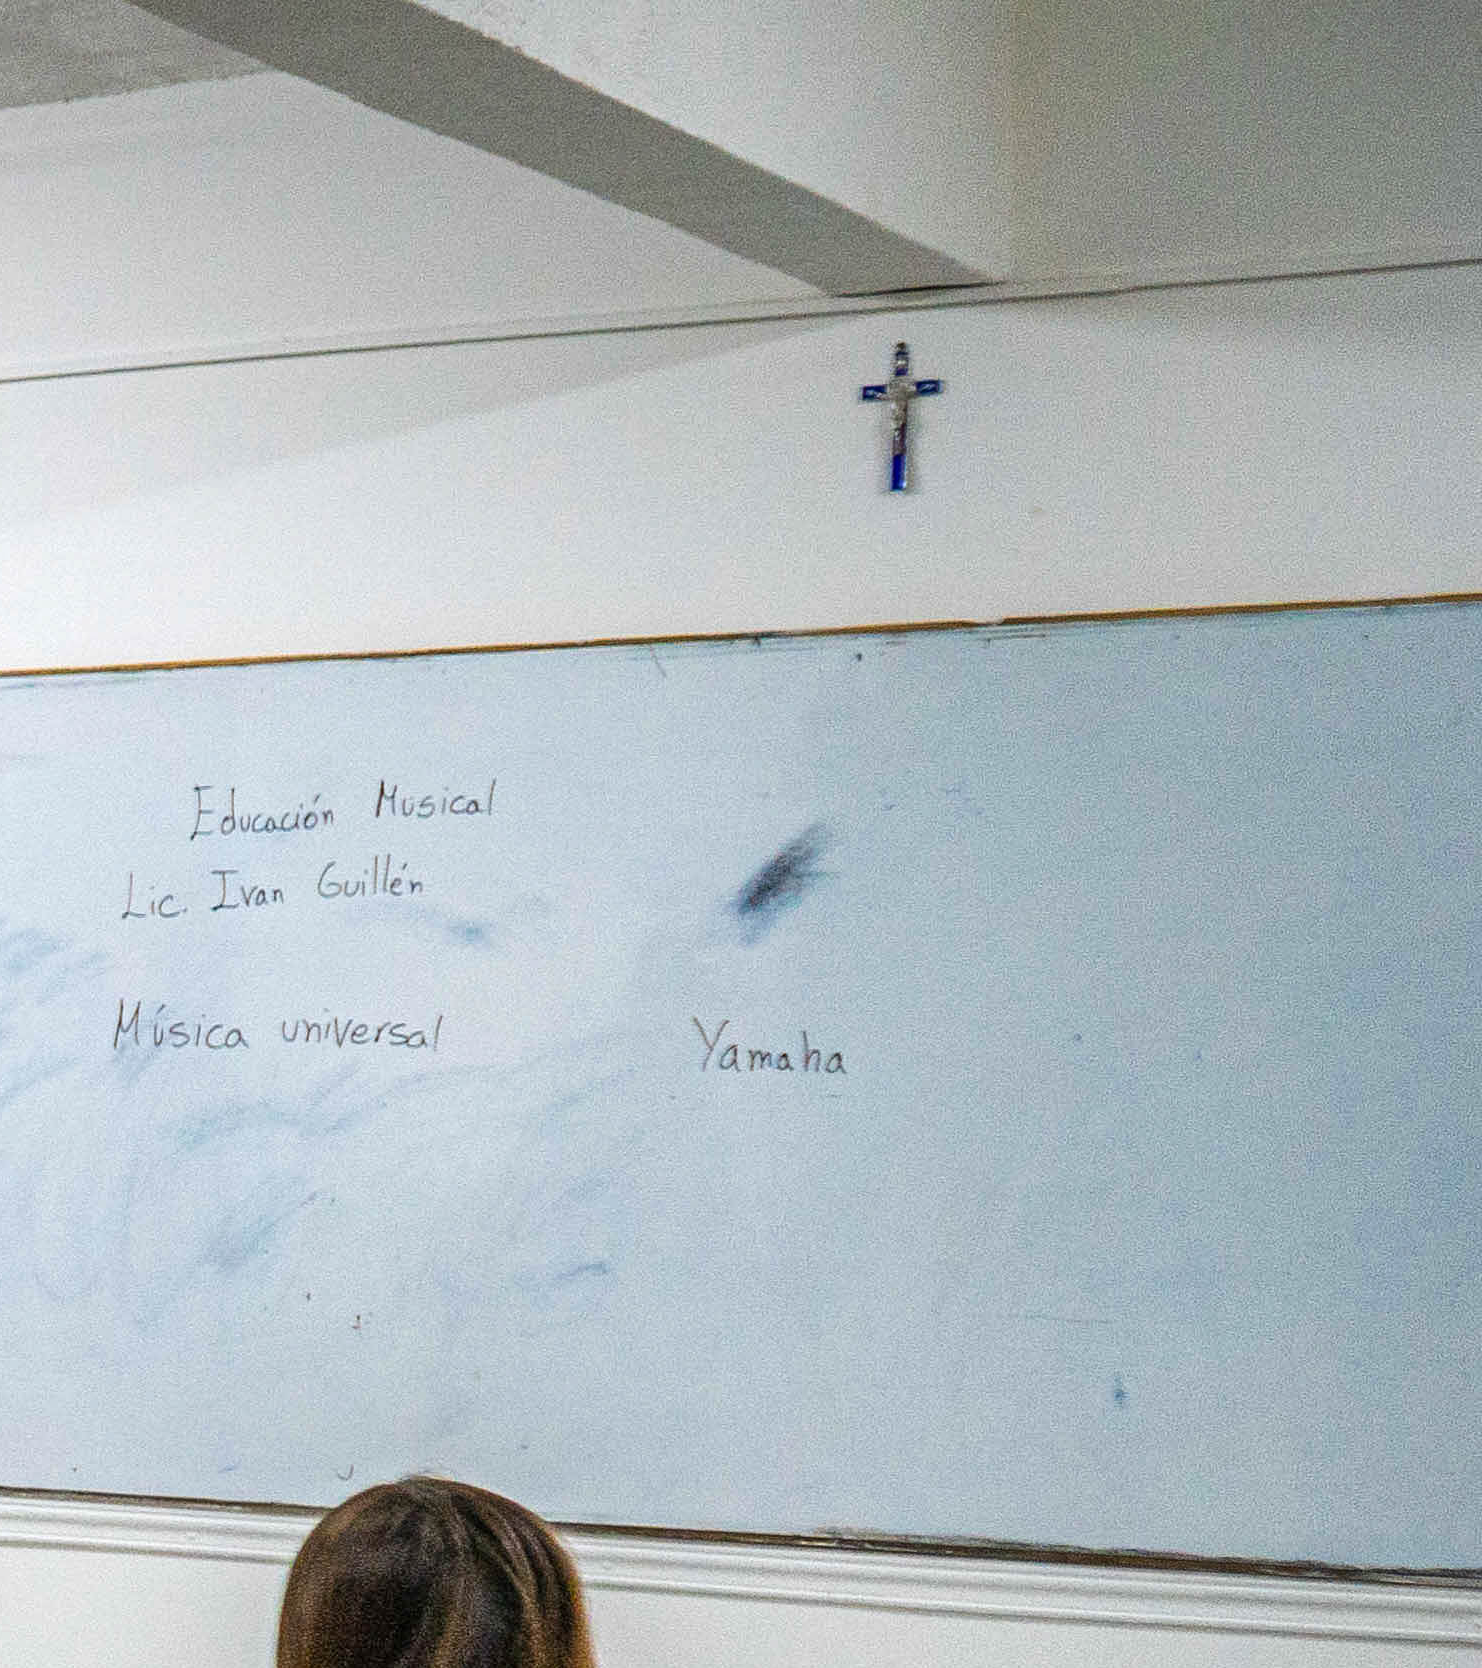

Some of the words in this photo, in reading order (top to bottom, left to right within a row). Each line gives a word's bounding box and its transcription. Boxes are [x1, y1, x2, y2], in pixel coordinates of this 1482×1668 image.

[189, 783, 335, 842] Educación
[374, 778, 498, 820] Musical
[120, 870, 189, 921] Lic.
[210, 868, 285, 913] Ivan
[317, 853, 424, 900] Guillén
[112, 998, 250, 1051] Música
[281, 1013, 444, 1051] universal
[692, 1016, 848, 1075] Yamaha
